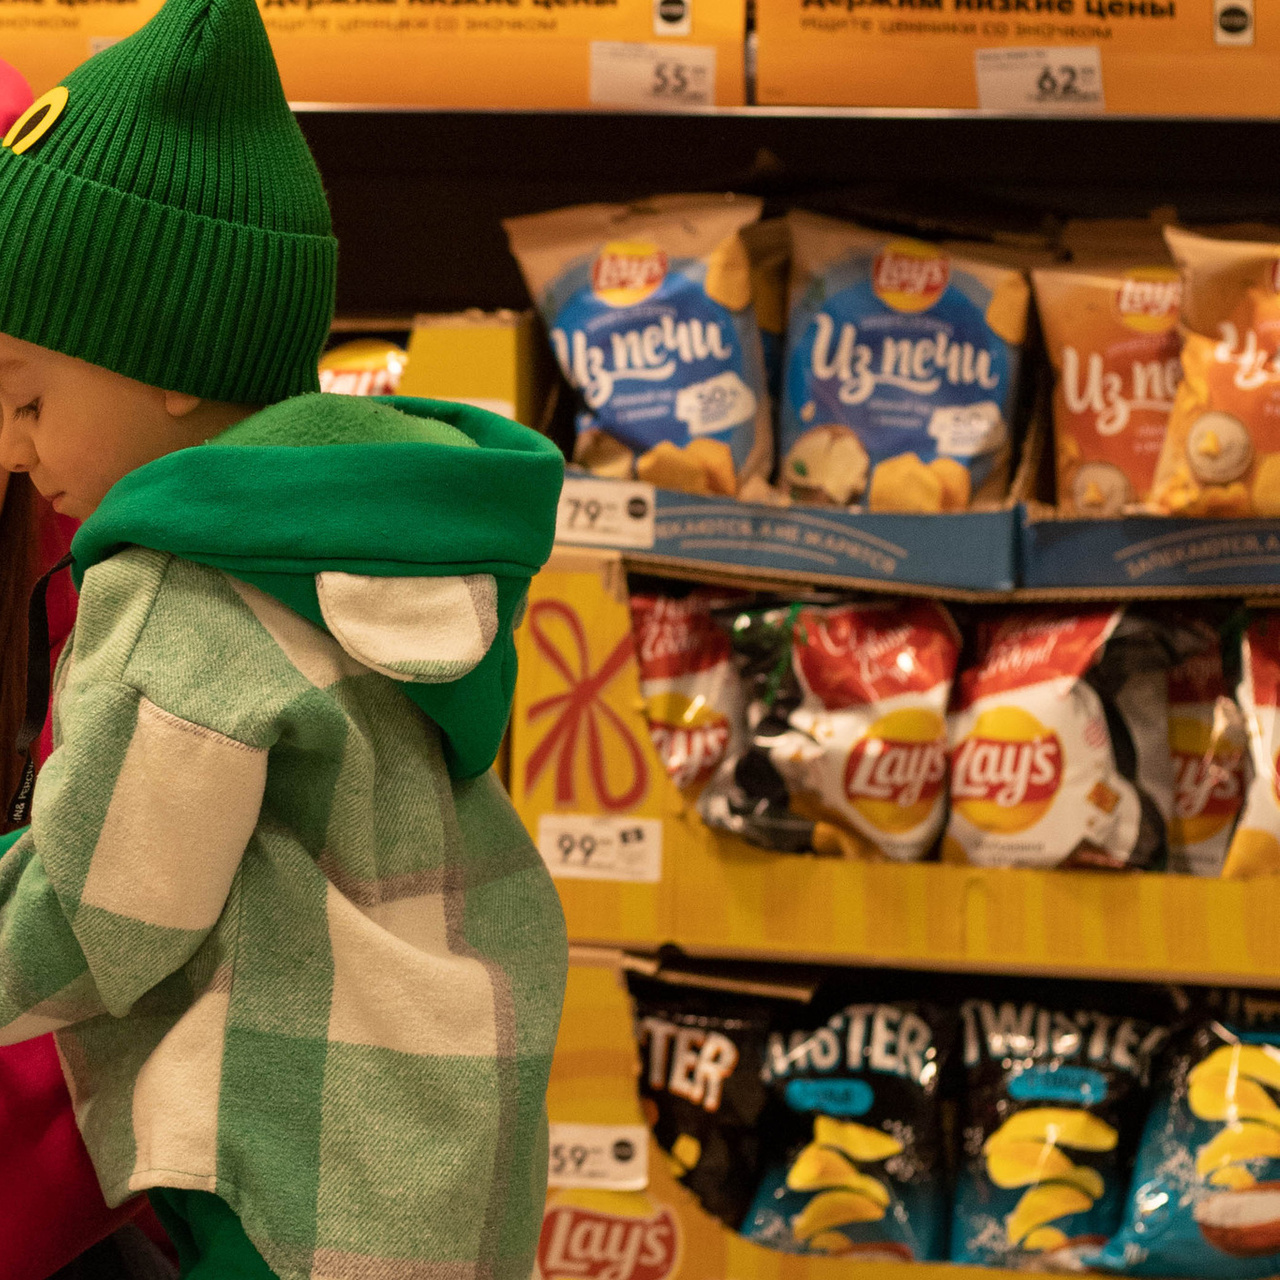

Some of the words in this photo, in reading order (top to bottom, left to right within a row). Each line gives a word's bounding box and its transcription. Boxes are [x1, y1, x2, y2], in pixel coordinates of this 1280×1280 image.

[651, 62, 689, 96] 55
[1035, 64, 1080, 94] 62
[552, 328, 614, 410] Из
[611, 316, 732, 372] печи
[811, 313, 876, 405] Из
[881, 331, 1000, 389] печи
[1063, 345, 1131, 437] Из
